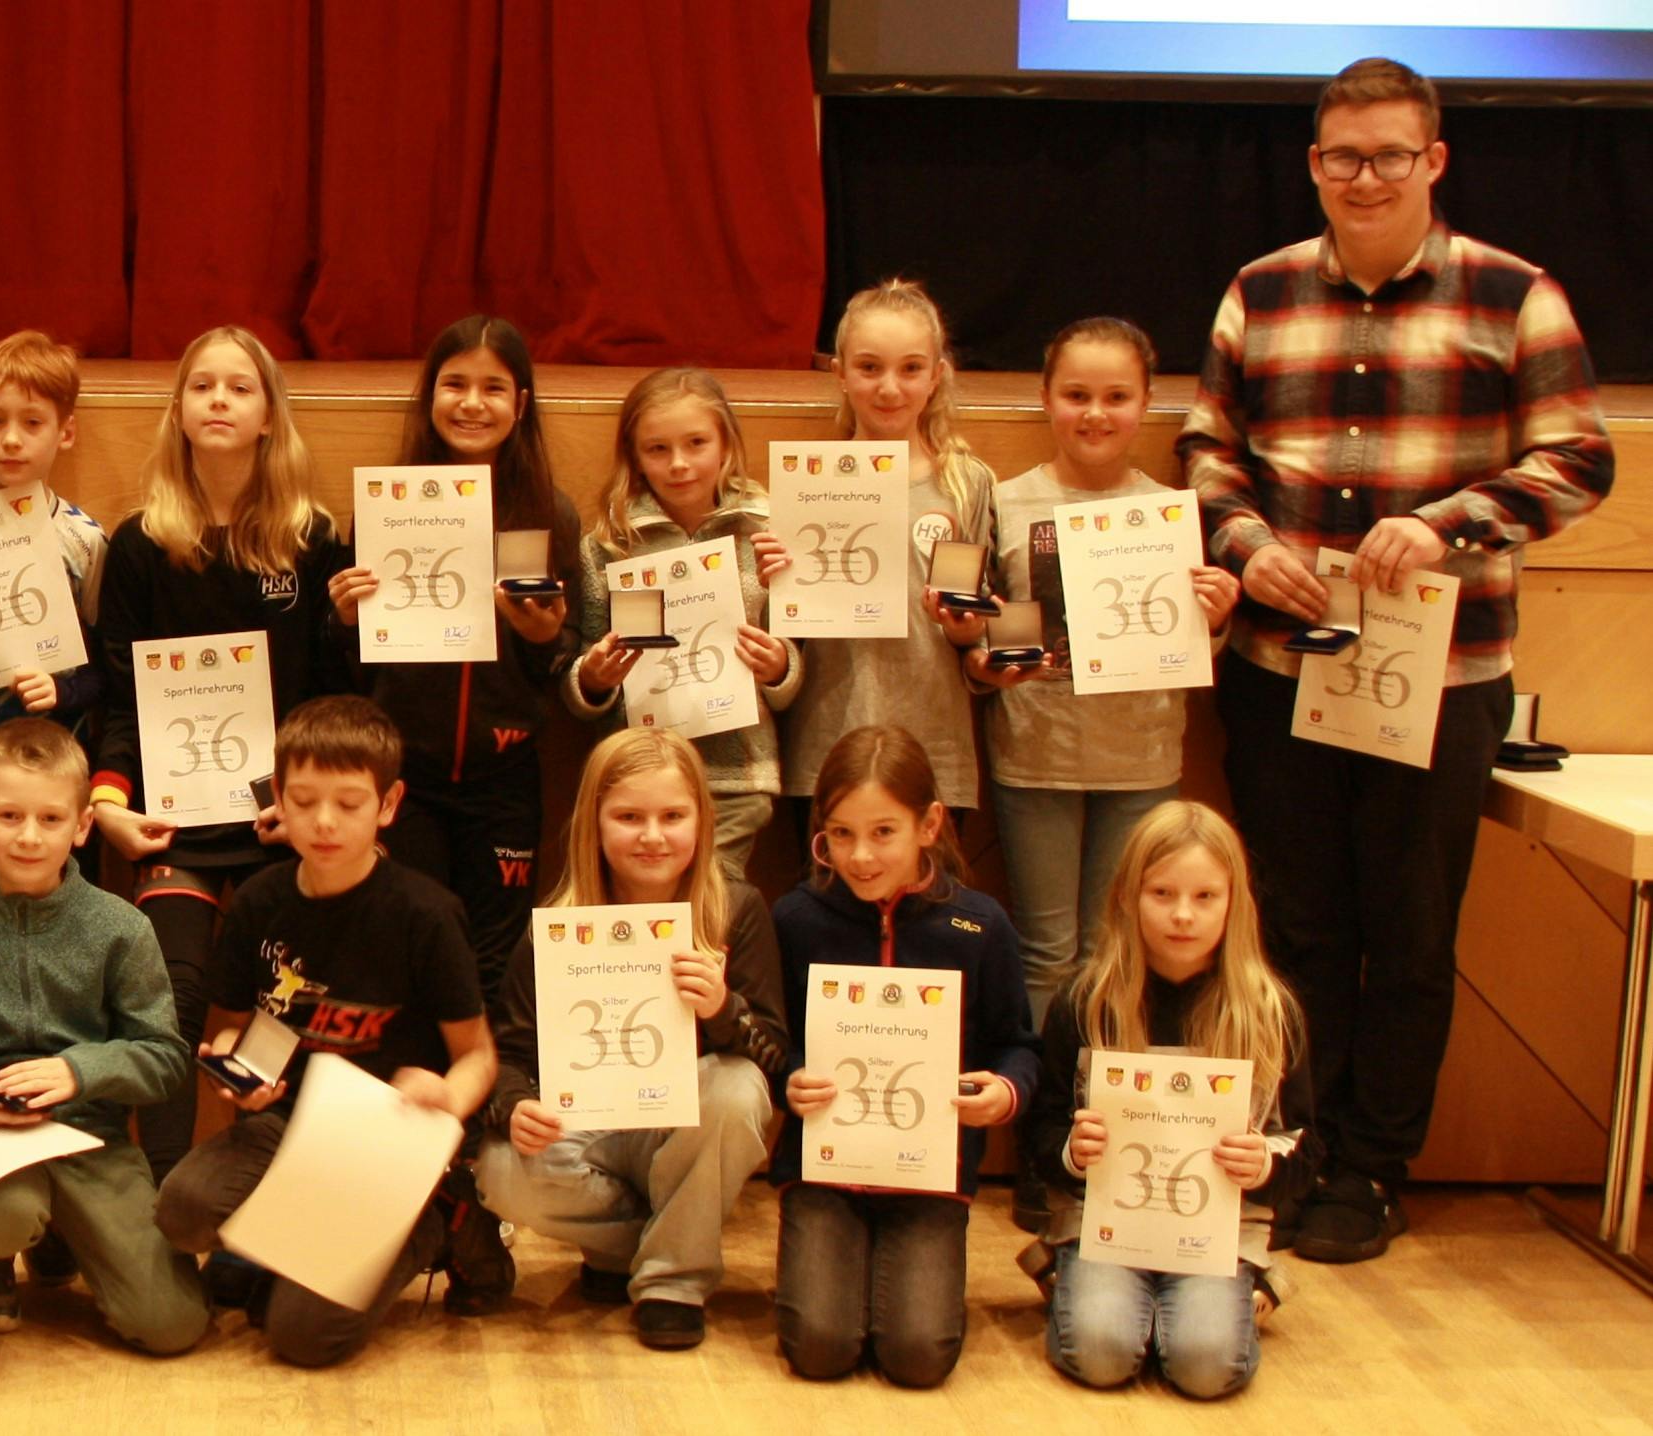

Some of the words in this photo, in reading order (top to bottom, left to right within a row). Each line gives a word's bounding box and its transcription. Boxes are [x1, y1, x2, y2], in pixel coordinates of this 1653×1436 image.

[797, 490, 882, 504] Sportlerehrung
[383, 515, 466, 530] Sportlerehrung
[916, 522, 952, 542] HSK
[1034, 525, 1056, 539] AR
[794, 522, 880, 586] 36
[1089, 542, 1175, 560] Sportlerehrung
[261, 574, 293, 595] HSK
[383, 546, 466, 611] 36
[663, 591, 716, 611] tlerehrung
[1092, 571, 1180, 641] 36
[1364, 608, 1423, 634] tlerehrung
[163, 683, 245, 700] Sportlerehrung
[166, 711, 250, 778] 36
[566, 961, 662, 978] Sportlerehrung
[601, 996, 630, 1007] Silber
[306, 1001, 396, 1041] HSK
[835, 1020, 929, 1041] Sportlerehrung
[568, 995, 665, 1071] 36
[867, 1056, 895, 1067] Silber
[831, 1056, 926, 1131] 36
[1121, 1107, 1217, 1128] Sportlerehrung
[1152, 1143, 1181, 1155] Silber
[1113, 1142, 1212, 1218] 36
